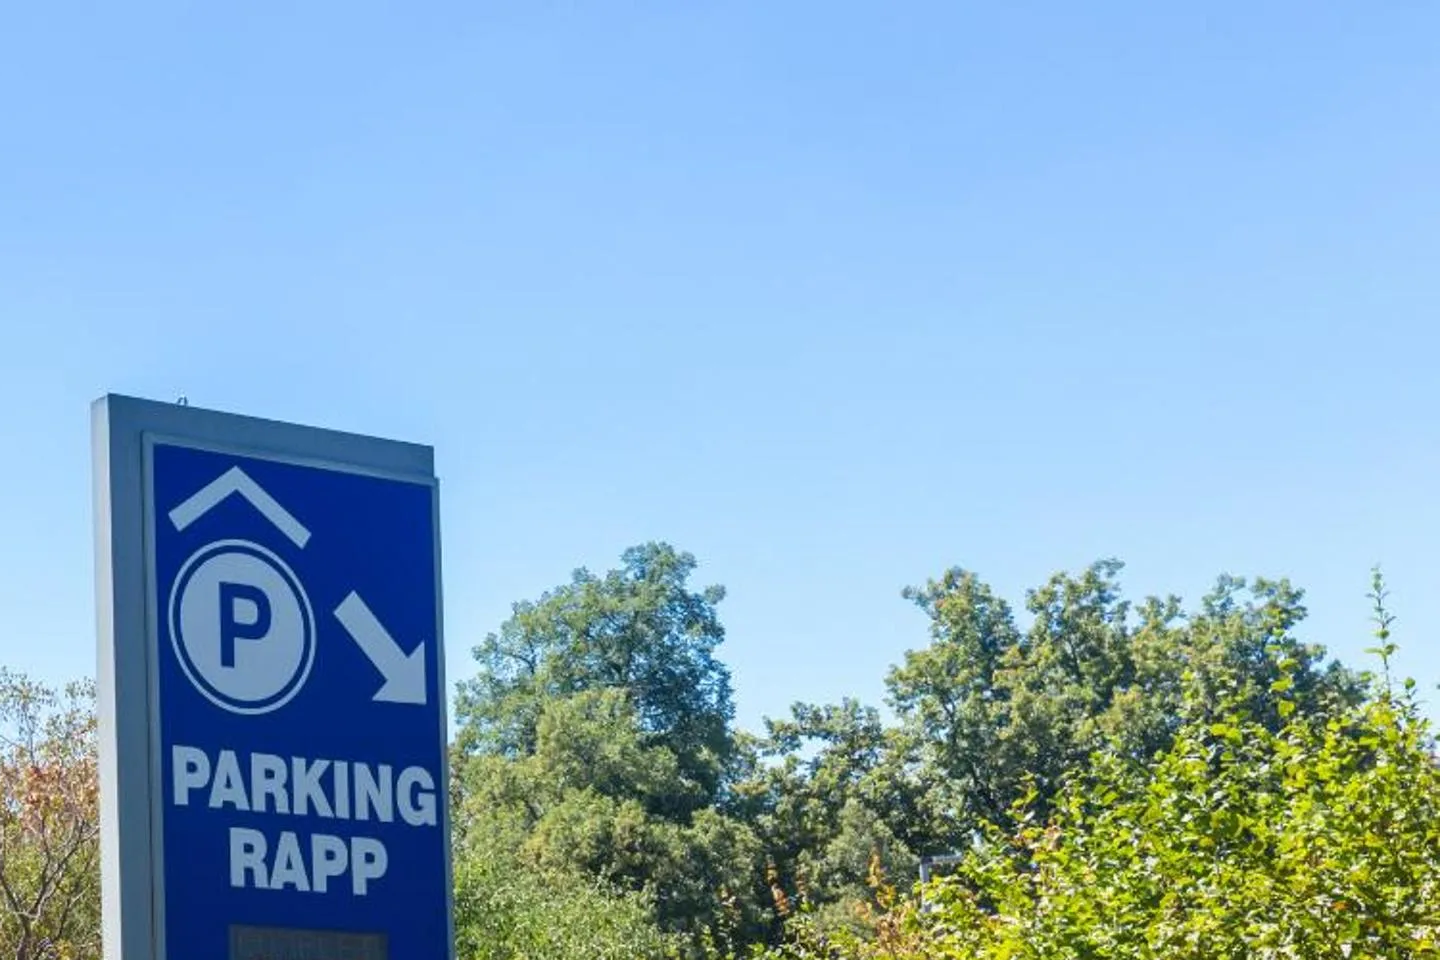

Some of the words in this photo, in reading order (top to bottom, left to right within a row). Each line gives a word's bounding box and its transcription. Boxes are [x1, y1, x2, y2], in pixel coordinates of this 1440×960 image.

[219, 581, 272, 668] P
[172, 744, 437, 827] PARKING
[229, 827, 388, 896] RAPP
